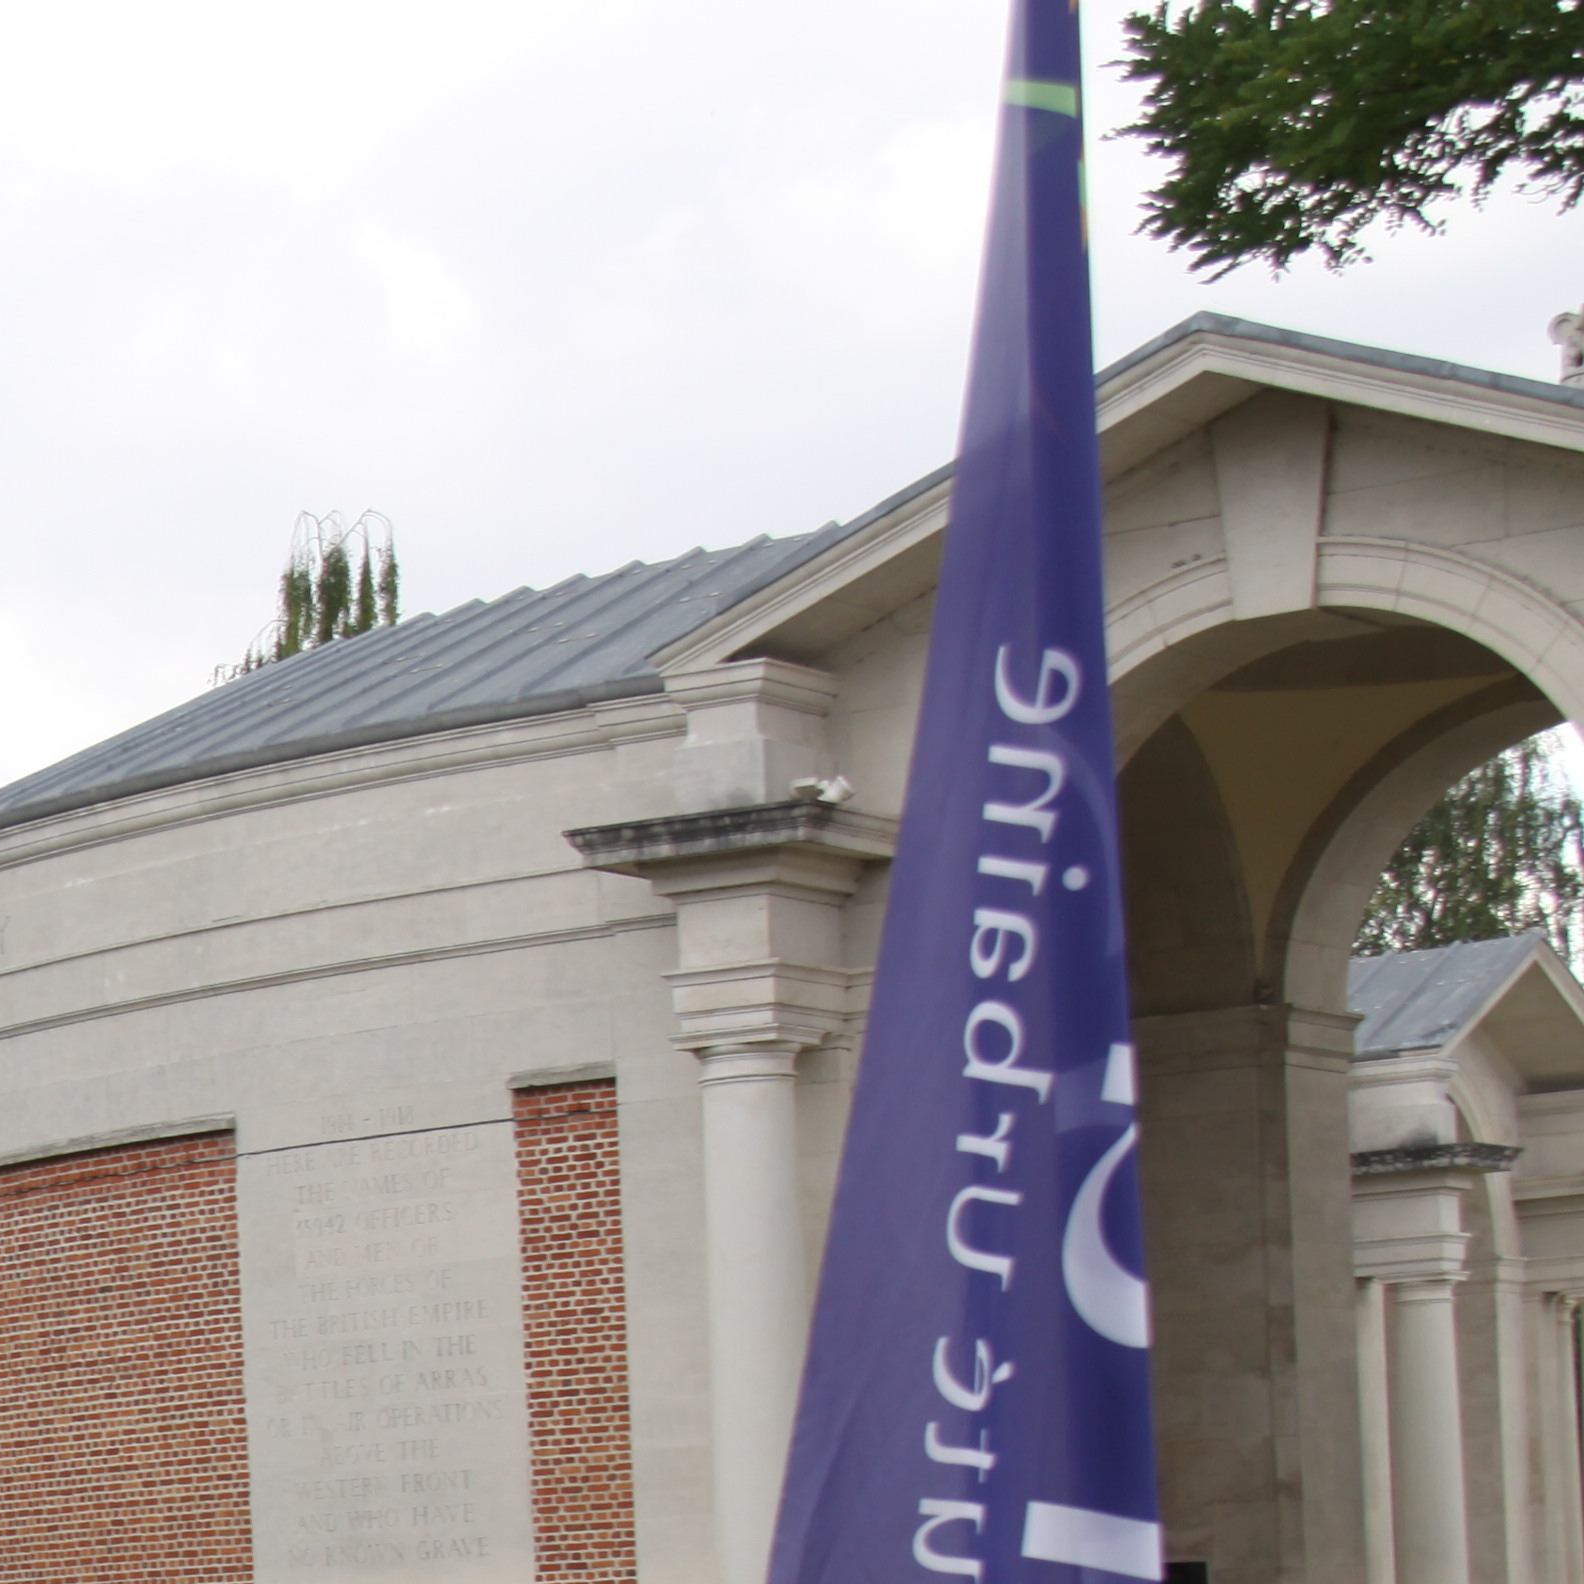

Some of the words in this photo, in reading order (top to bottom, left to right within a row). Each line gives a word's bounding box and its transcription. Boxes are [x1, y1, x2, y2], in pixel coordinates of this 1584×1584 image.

[266, 1152, 316, 1176] HERE
[370, 1131, 480, 1161] RECORDED
[295, 1182, 334, 1205] THE
[343, 1175, 413, 1200] NAMES
[424, 1168, 451, 1188] OF
[355, 1202, 454, 1230] OFFICERS
[306, 1248, 346, 1270] AND
[412, 1237, 440, 1257] OF
[298, 1283, 339, 1304] THE
[346, 1274, 415, 1299] FORCES
[426, 1269, 452, 1289] OF
[269, 1319, 309, 1340] THE
[318, 1308, 398, 1335] BRITISH
[410, 1299, 489, 1325] EMPIRE
[283, 1350, 331, 1370] WHO
[342, 1342, 392, 1367] FELL
[402, 1339, 422, 1360] IN
[436, 1334, 476, 1357] THE
[379, 1374, 406, 1395] OF
[415, 1366, 488, 1392] ARRAS
[267, 1418, 292, 1438] OR
[376, 1399, 504, 1429] OPERATIONS
[320, 1443, 387, 1467] ABOVE
[398, 1438, 440, 1461] THE
[294, 1477, 387, 1501] WESTERN
[400, 1469, 473, 1494] FRONT
[294, 1513, 338, 1535] AND
[348, 1509, 399, 1530] WHO
[412, 1503, 475, 1526] HAVE
[288, 1547, 317, 1570] NO
[325, 1543, 405, 1567] KNOWN
[416, 1536, 490, 1562] GRAVE
